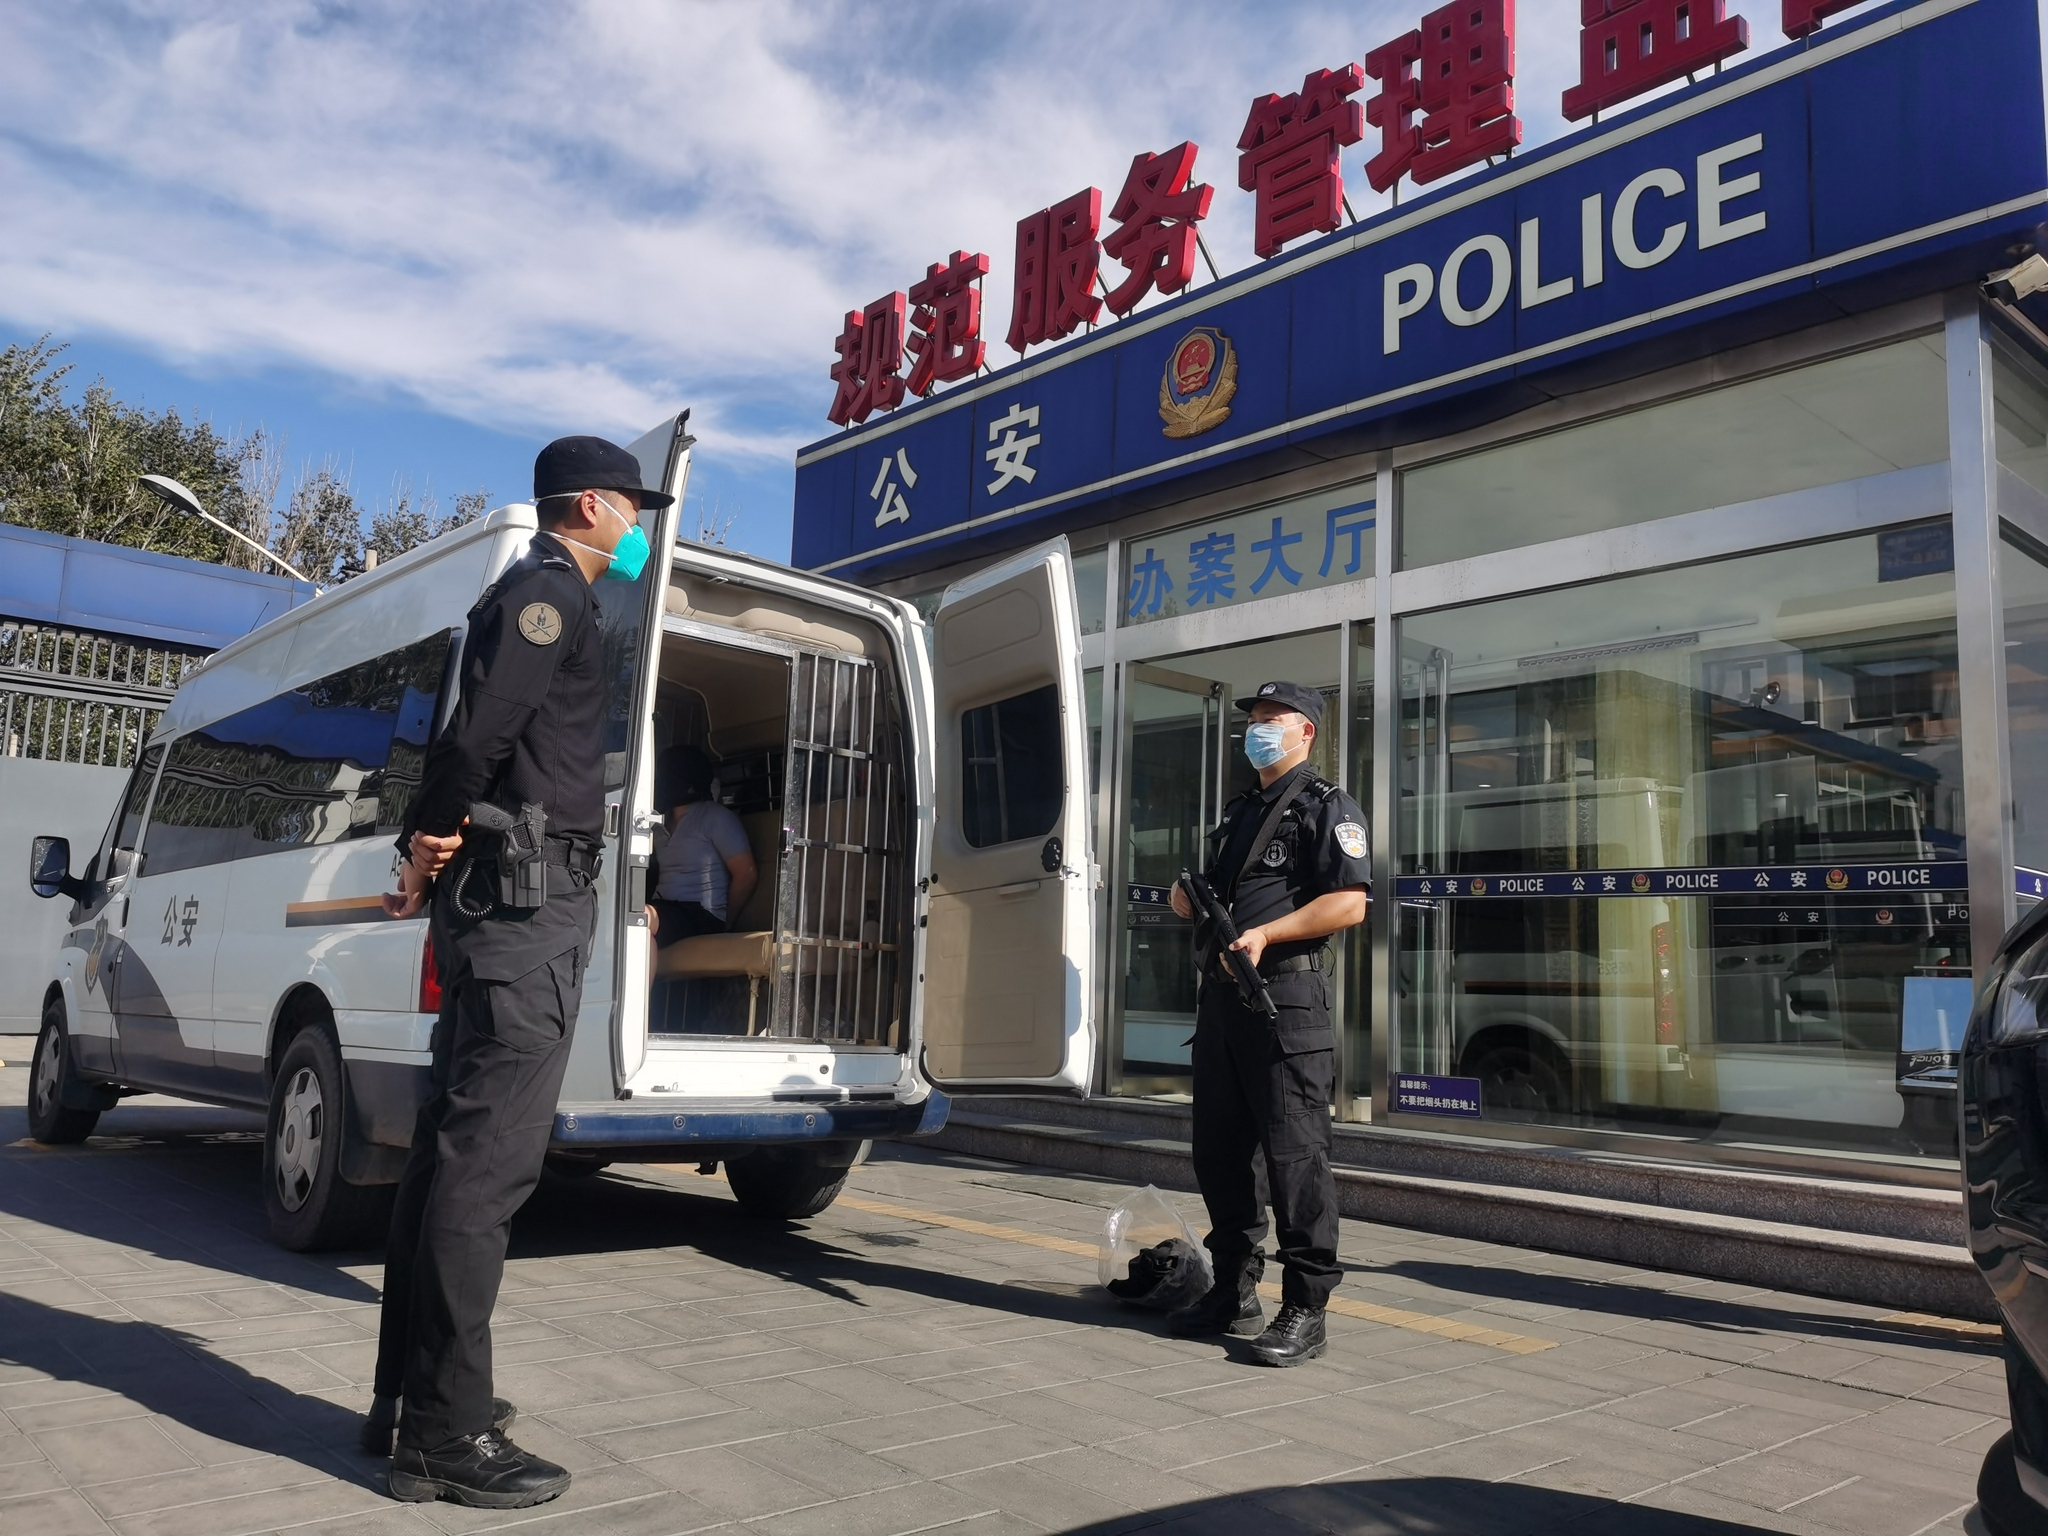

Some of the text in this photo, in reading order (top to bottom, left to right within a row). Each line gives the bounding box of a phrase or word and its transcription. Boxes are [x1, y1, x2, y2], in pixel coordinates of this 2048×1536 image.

[827, 250, 989, 427] 规范
[1005, 140, 1215, 353] 服务
[1236, 0, 1522, 259] 管理
[870, 133, 1766, 528] 公安 POLICE
[1128, 499, 1376, 617] 办案大厅
[1132, 888, 1159, 902] 公安
[1420, 869, 1930, 894] 公安 POLICE 公安 POLICE 公安 POLICE
[161, 894, 199, 947] 公安
[1140, 915, 1161, 923] POLICE
[1400, 1095, 1477, 1111] 不要把烟头扔在地上
